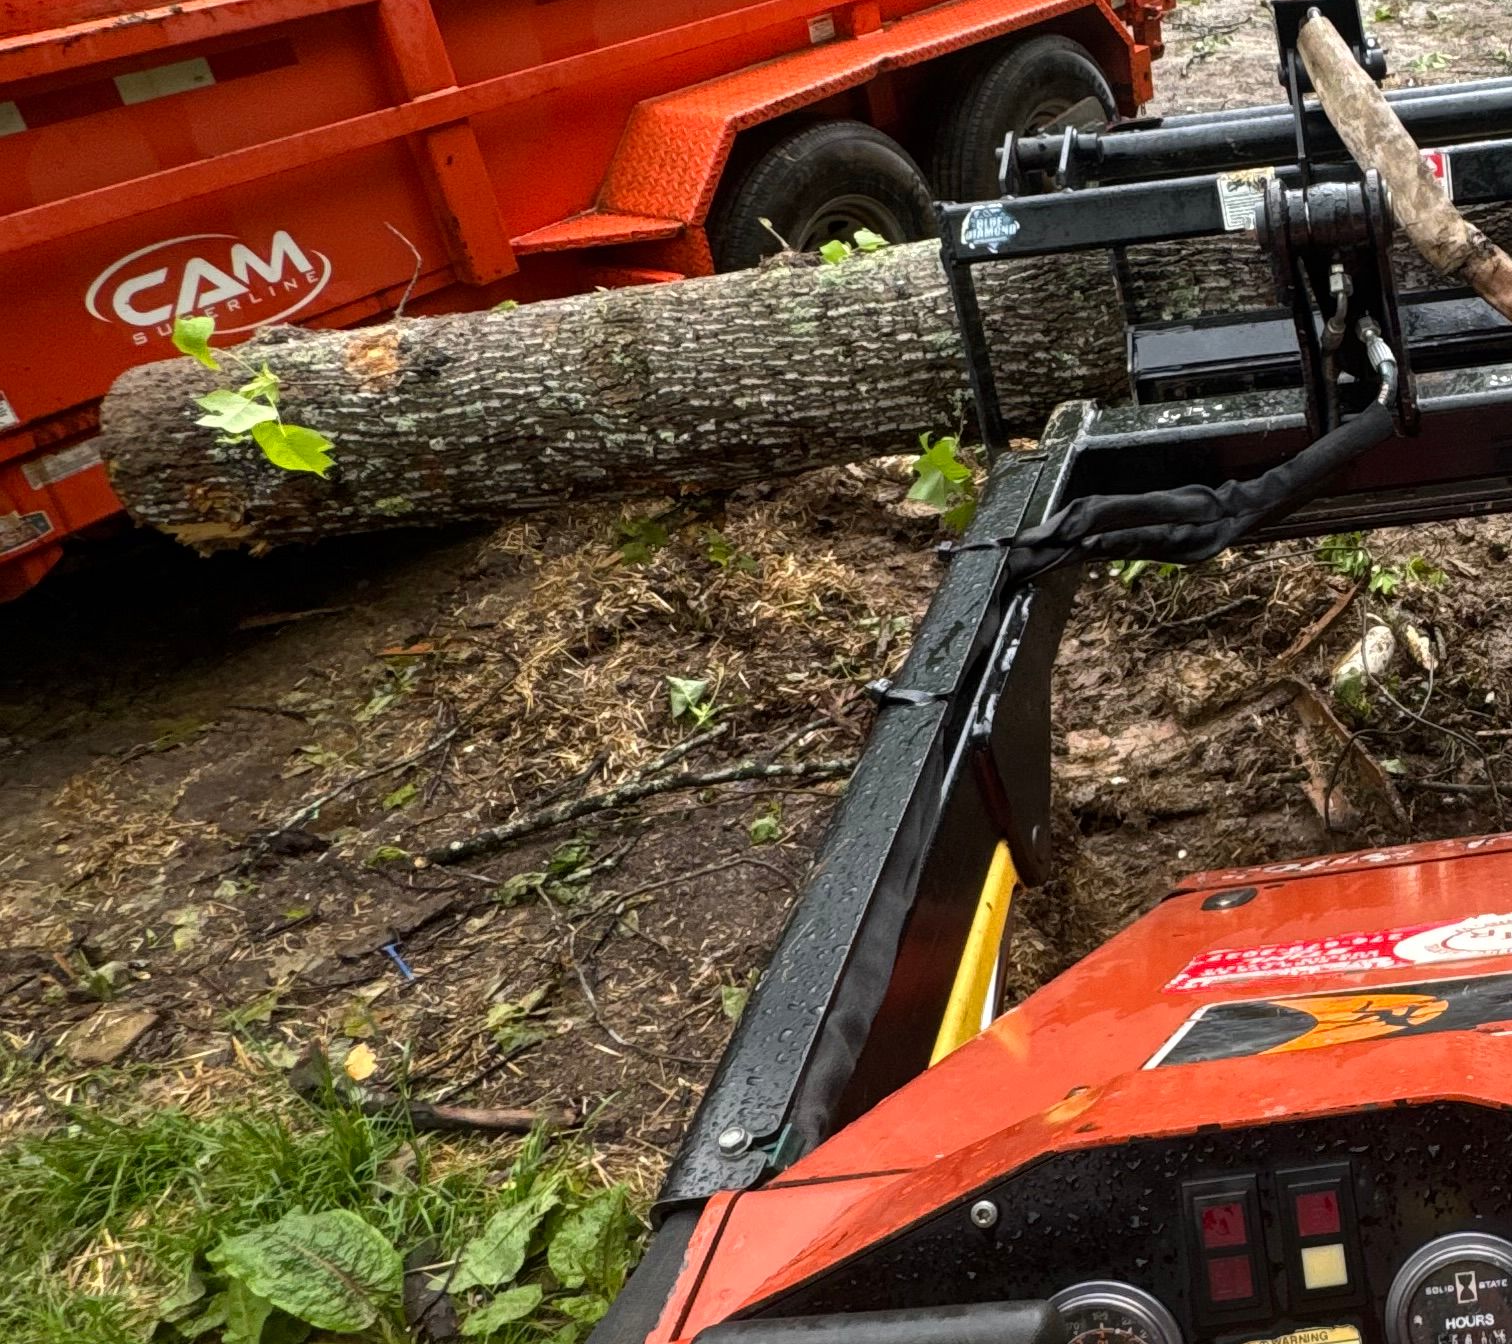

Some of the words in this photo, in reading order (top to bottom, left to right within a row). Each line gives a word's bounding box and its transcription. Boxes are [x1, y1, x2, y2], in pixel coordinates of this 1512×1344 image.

[112, 230, 314, 327] CAM
[1425, 1285, 1455, 1296] SOLID
[1478, 1278, 1508, 1290] STATE
[1445, 1313, 1495, 1330] HOURS
